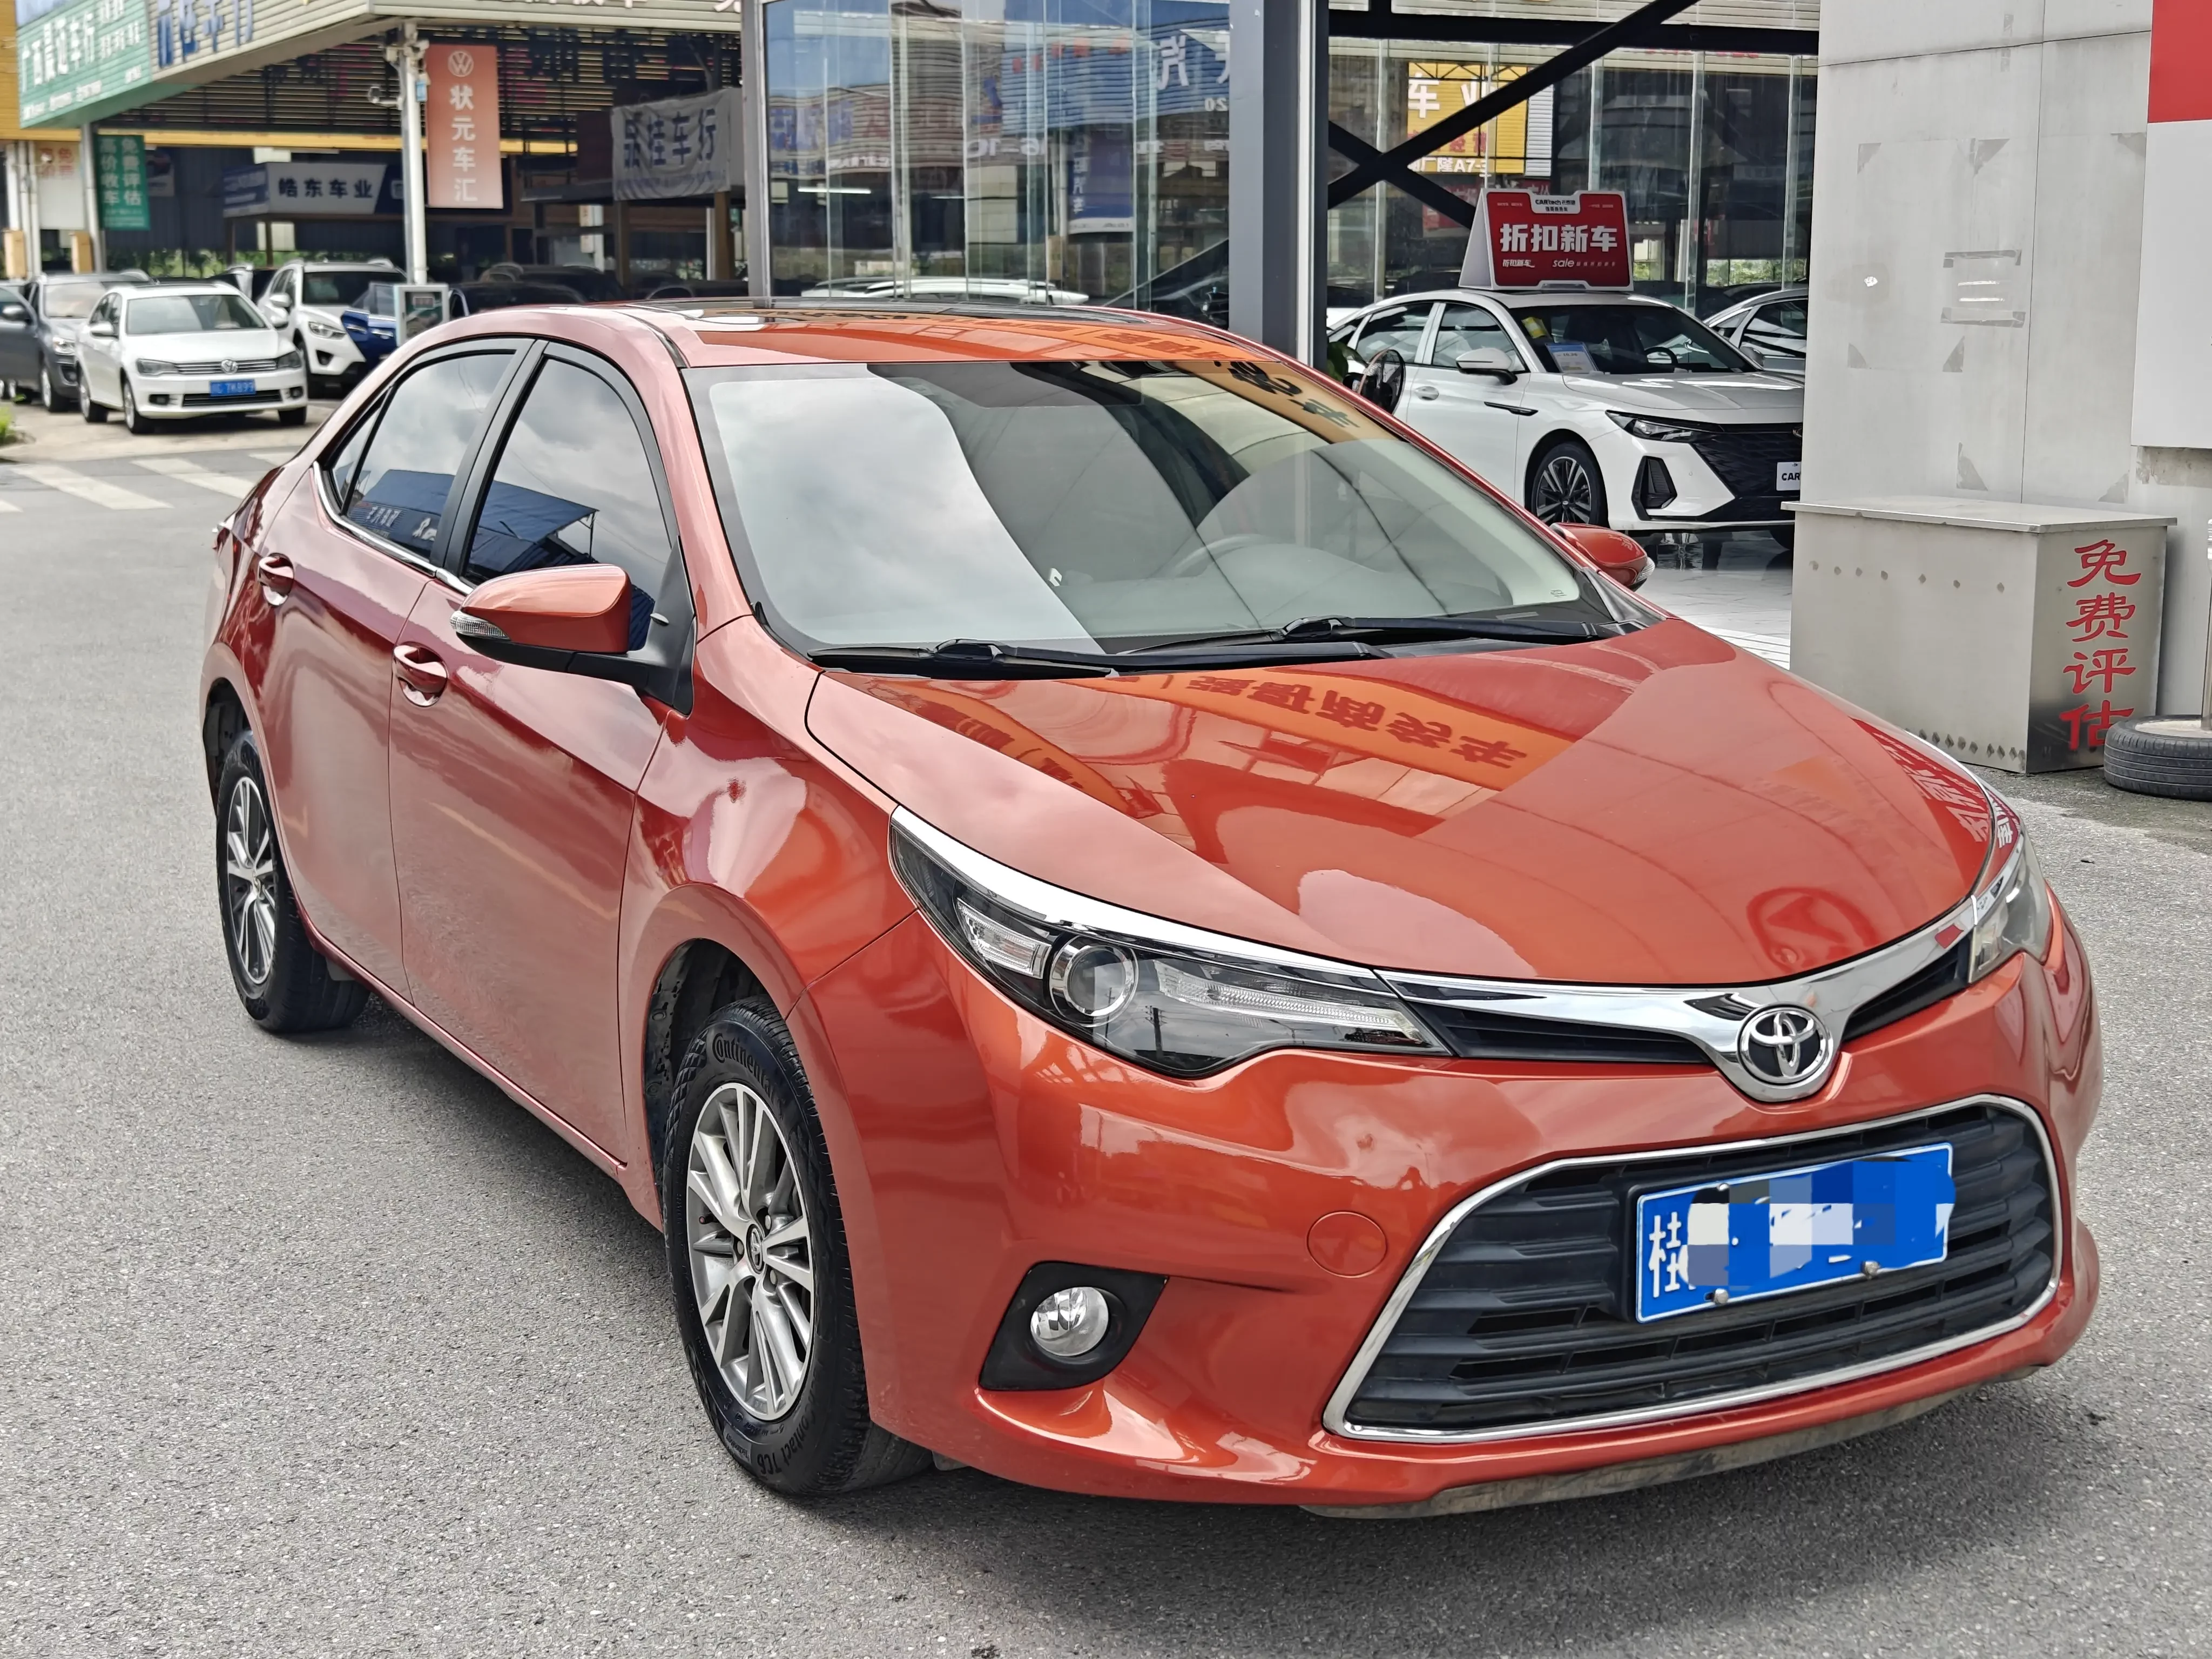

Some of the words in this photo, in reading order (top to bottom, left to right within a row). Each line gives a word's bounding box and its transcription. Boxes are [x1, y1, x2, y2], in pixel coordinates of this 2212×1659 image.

[449, 85, 478, 202] 状元车汇
[1500, 223, 1618, 253] 折扣新车
[1552, 258, 1575, 268] sale
[2059, 539, 2142, 751] 免费评估
